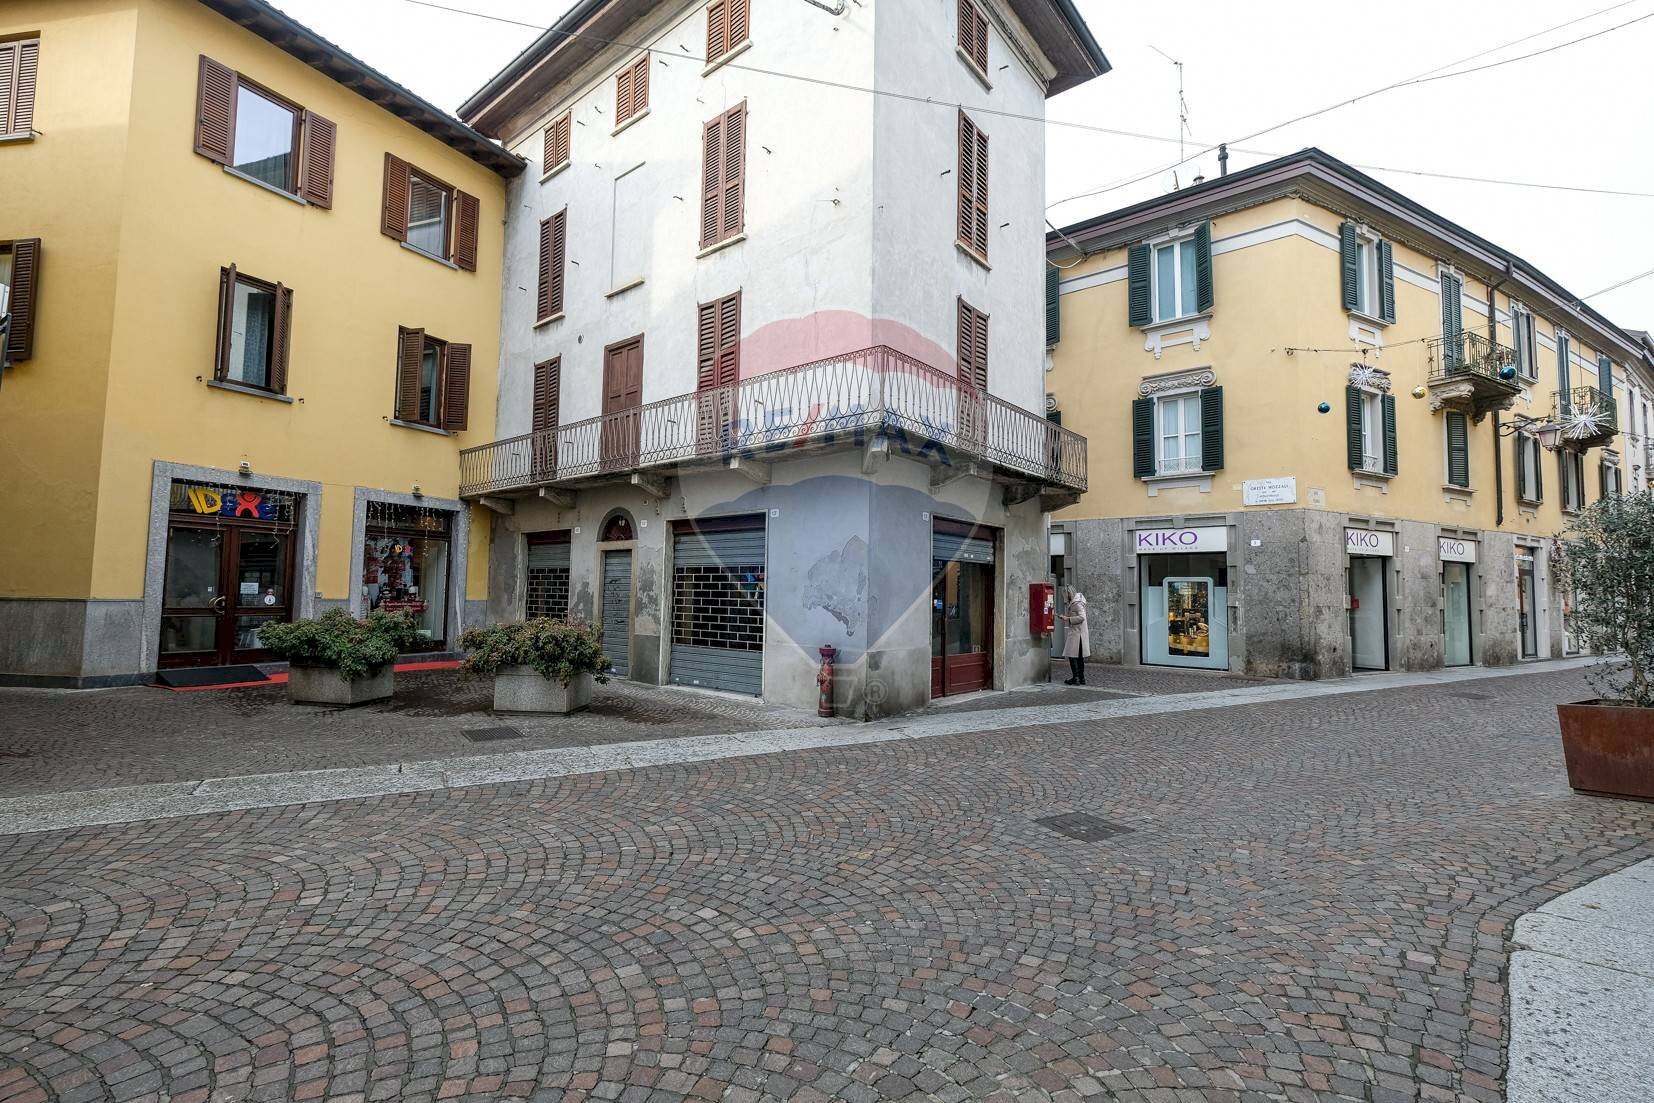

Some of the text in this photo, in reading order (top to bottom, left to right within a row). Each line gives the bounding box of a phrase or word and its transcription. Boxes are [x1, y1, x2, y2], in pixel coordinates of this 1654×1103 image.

[1139, 531, 1197, 546] KIKO
[1347, 531, 1379, 547] KIKO
[1439, 540, 1465, 555] KIKO
